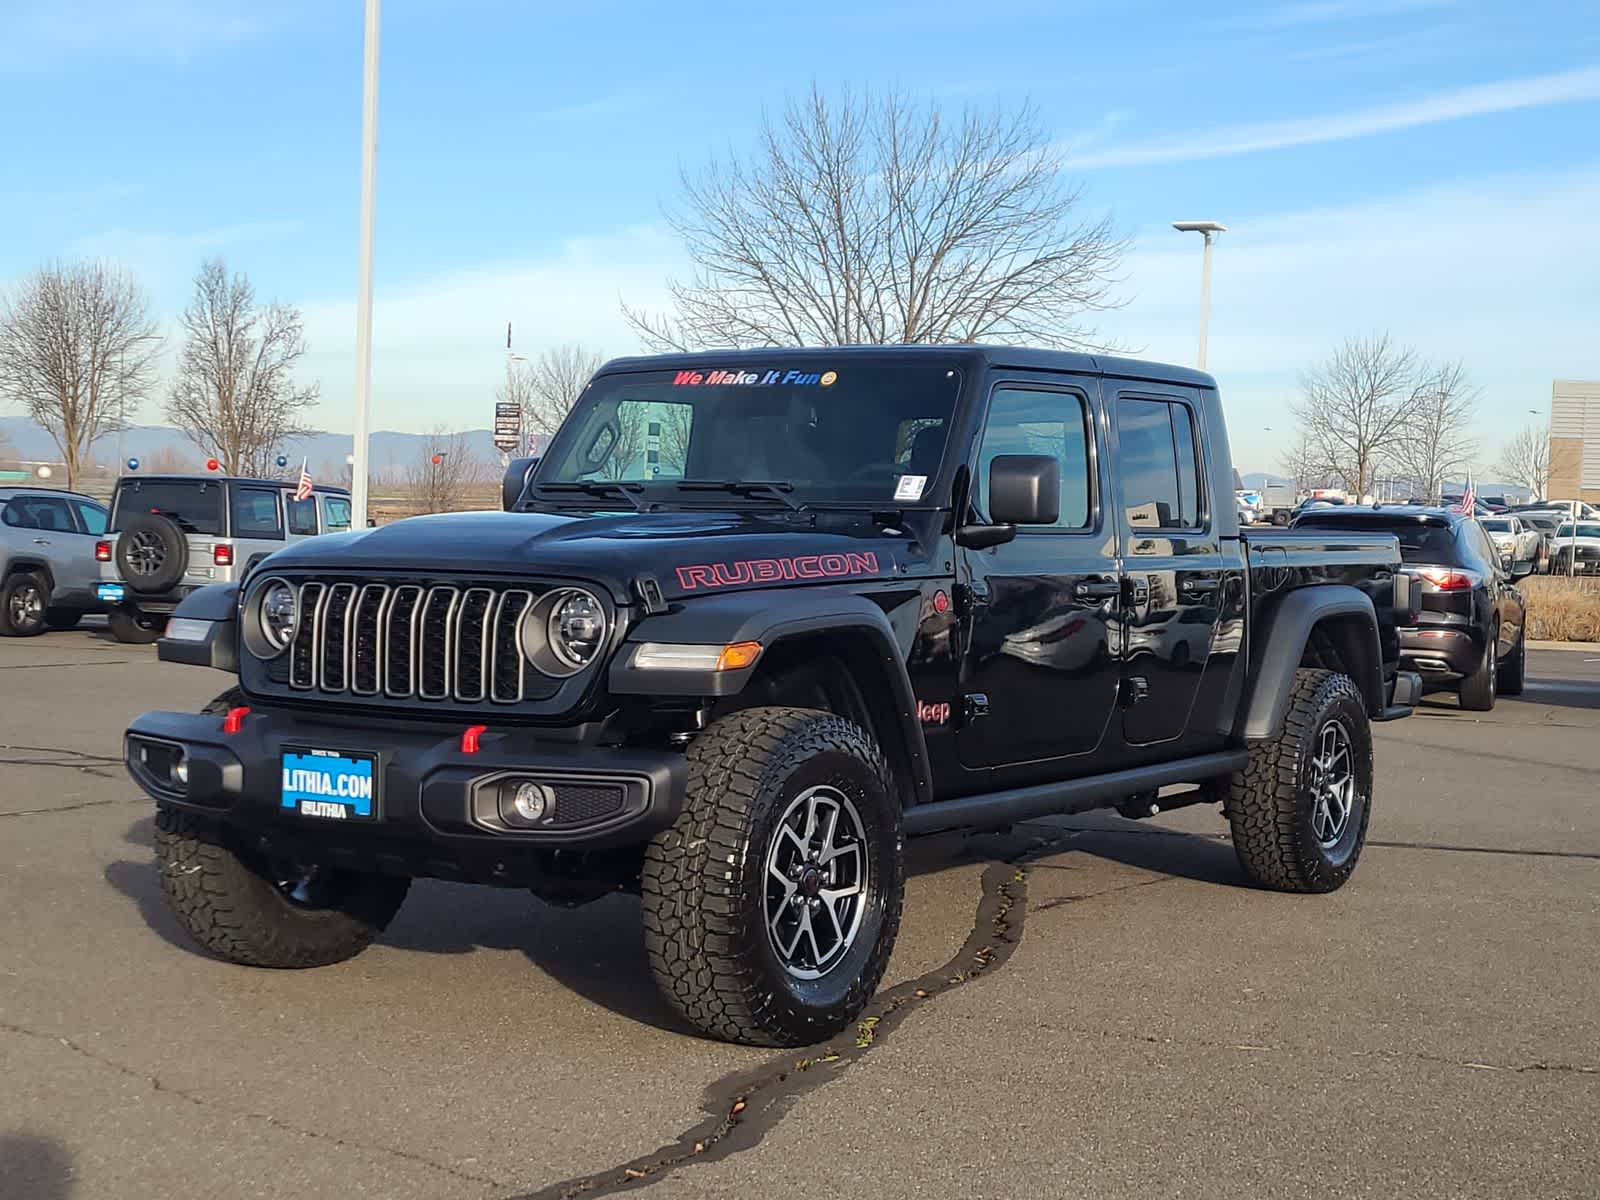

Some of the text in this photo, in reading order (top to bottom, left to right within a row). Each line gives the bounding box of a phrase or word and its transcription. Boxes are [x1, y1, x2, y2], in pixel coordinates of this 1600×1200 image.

[673, 370, 821, 386] We Make It Fun
[675, 552, 880, 590] RUBICON
[282, 768, 373, 800] LITHIA.COM
[313, 801, 347, 819] LITHIA
